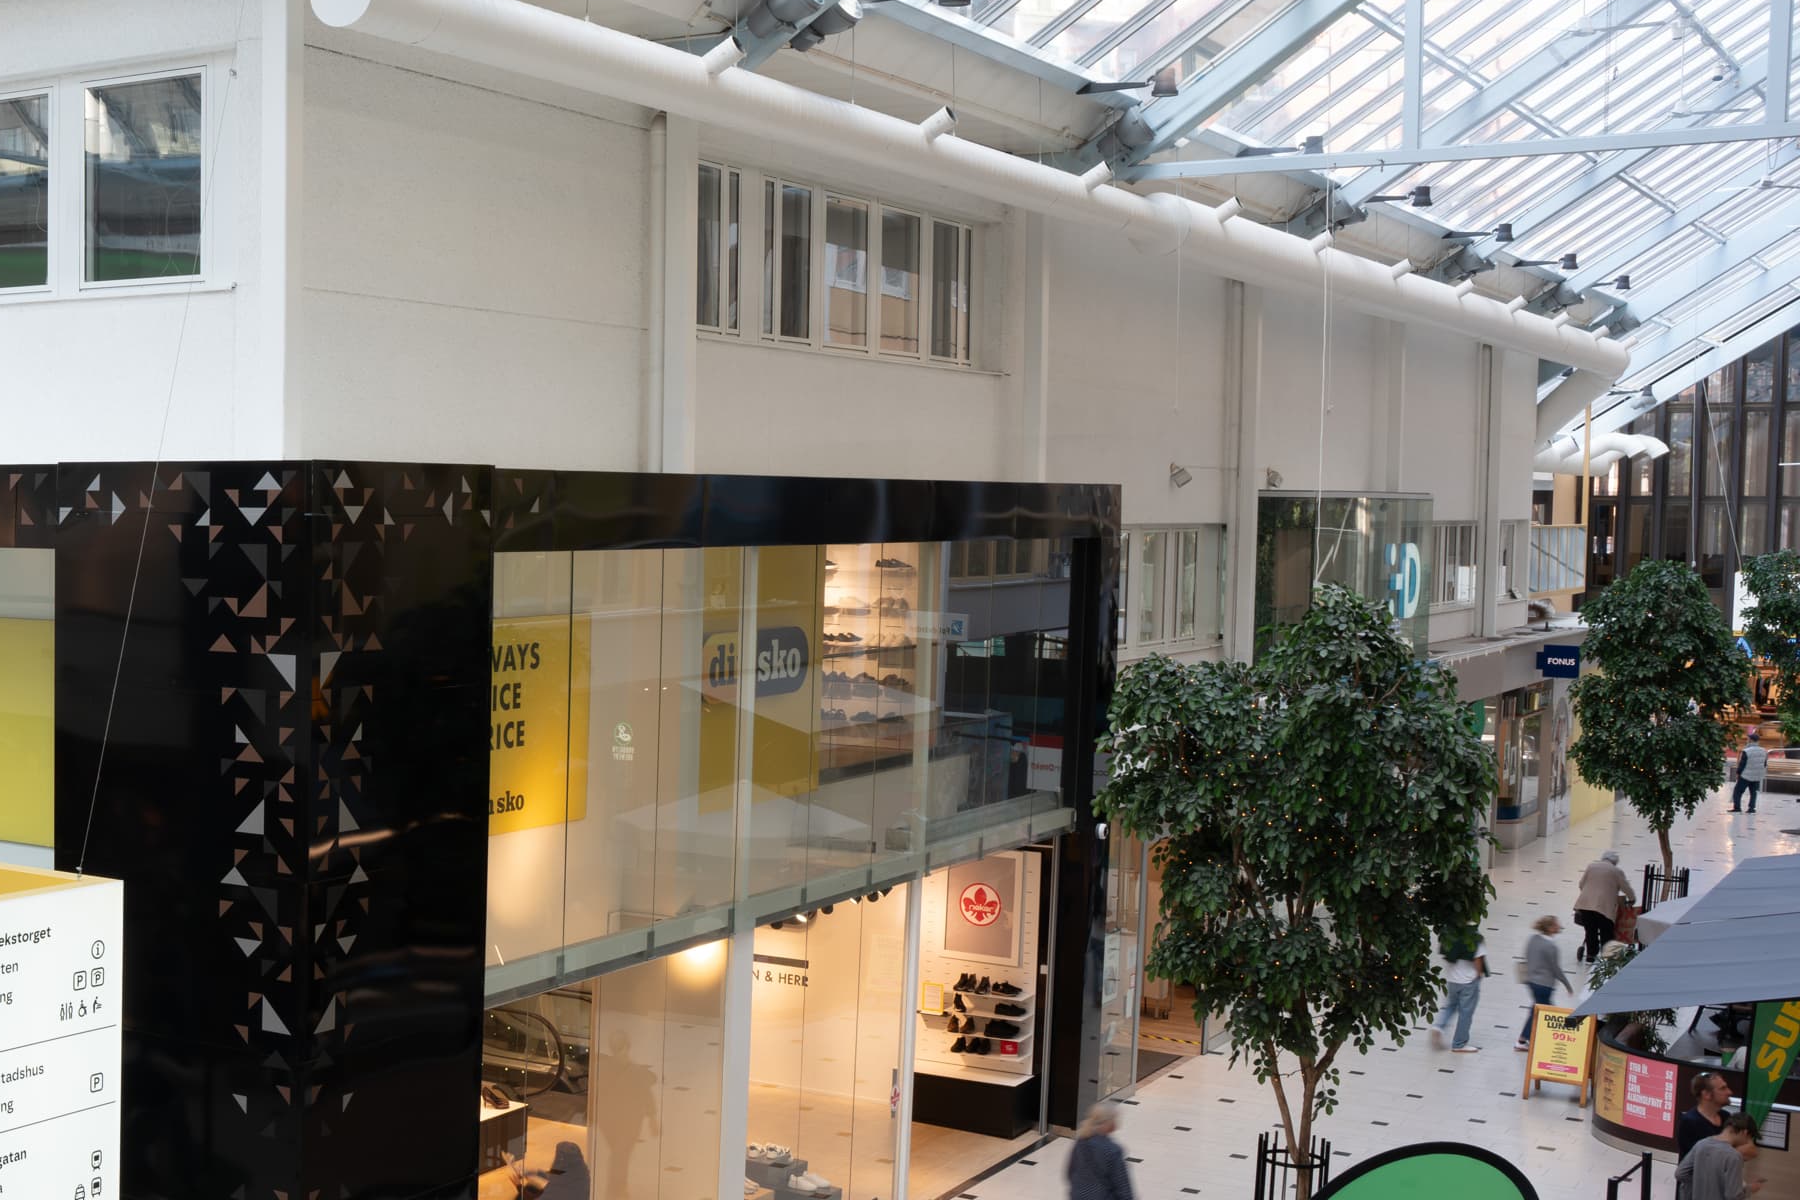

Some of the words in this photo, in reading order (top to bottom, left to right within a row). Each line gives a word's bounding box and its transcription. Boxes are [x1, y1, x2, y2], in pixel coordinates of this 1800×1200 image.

[758, 639, 801, 682] sko
[1547, 657, 1576, 666] FONUS
[491, 682, 521, 712] ICE
[496, 791, 525, 814] sko
[1552, 1032, 1565, 1041] 99
